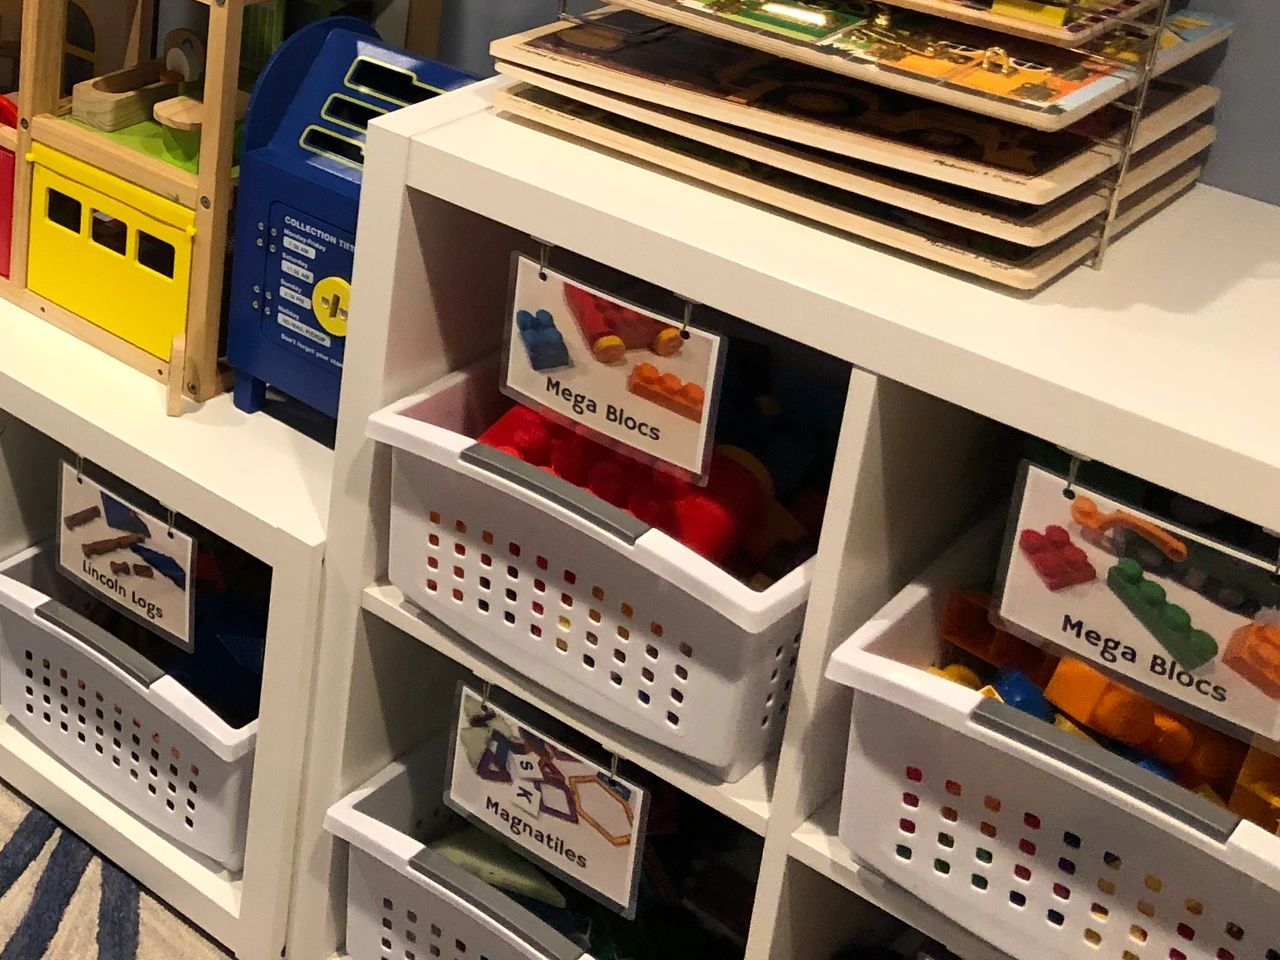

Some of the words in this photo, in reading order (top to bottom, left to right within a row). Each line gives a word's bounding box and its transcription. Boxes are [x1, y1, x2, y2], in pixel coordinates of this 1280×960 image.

[284, 215, 337, 244] COLLECTION
[545, 375, 597, 415] Mega
[605, 404, 660, 441] Blocs
[82, 559, 127, 597] Lincoln
[131, 590, 163, 620] Logs
[1061, 614, 1137, 664] Mega
[1149, 654, 1227, 702] Blocs
[516, 785, 533, 804] K
[485, 795, 587, 869] Magnatiles
